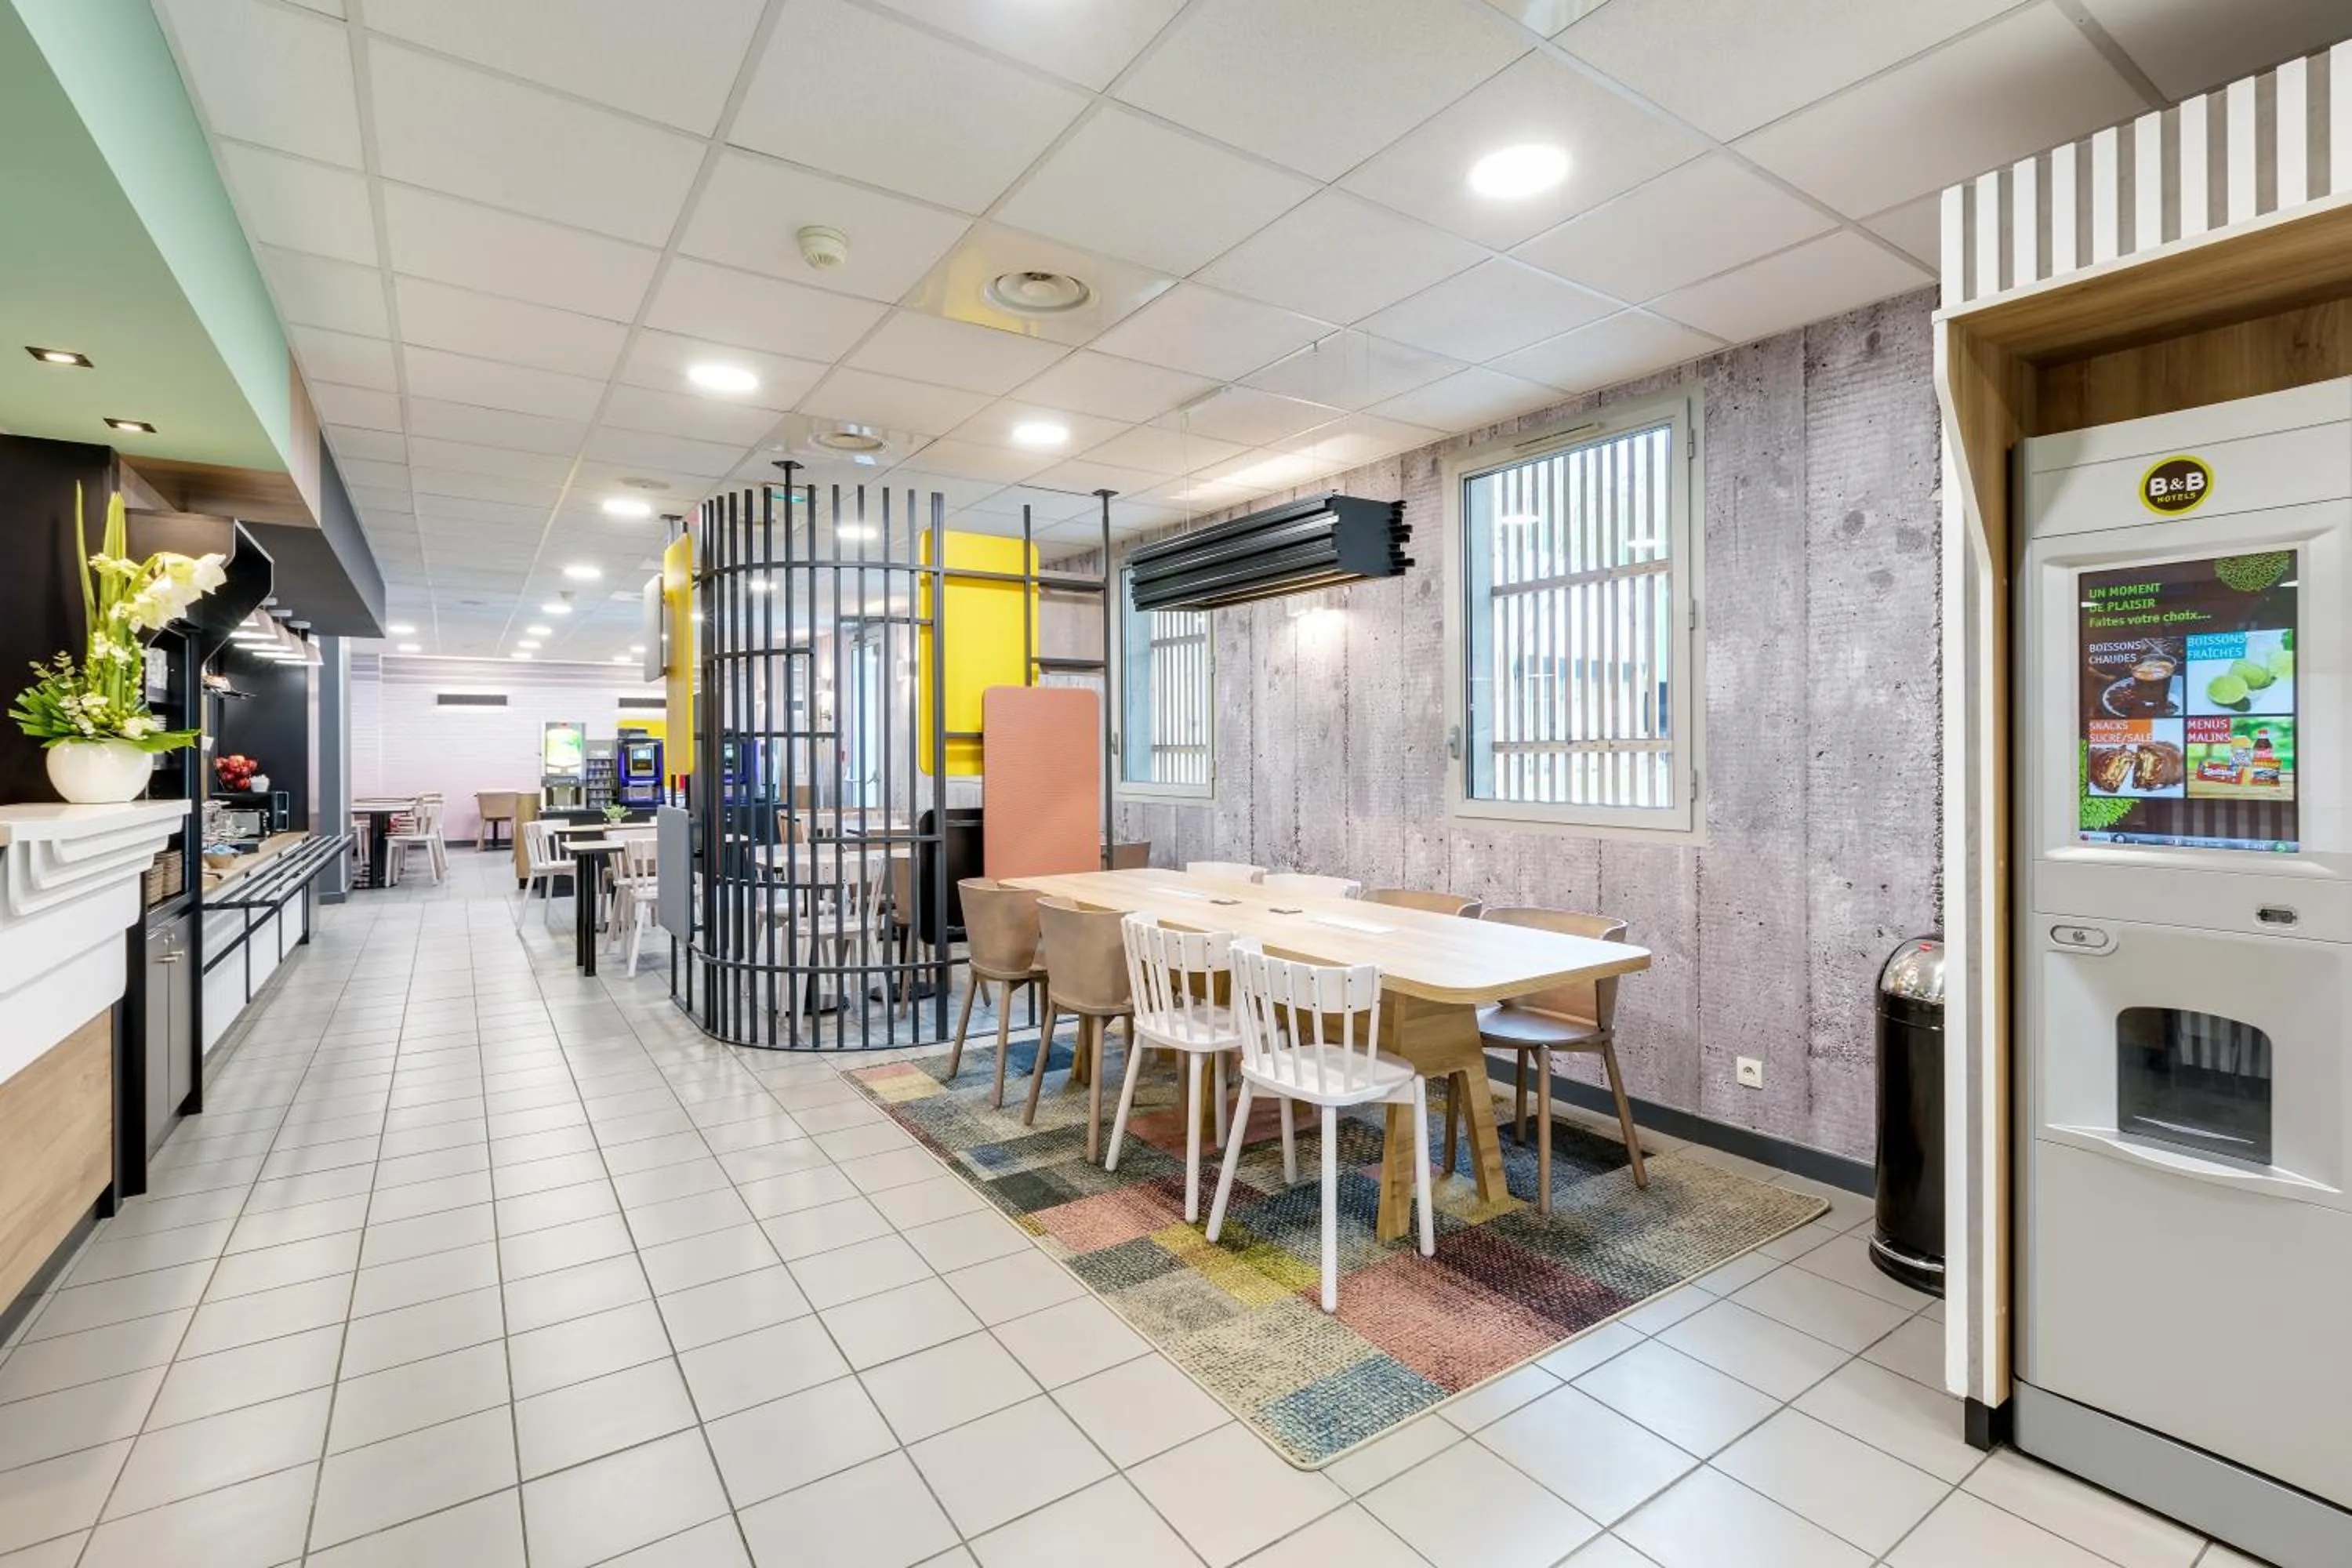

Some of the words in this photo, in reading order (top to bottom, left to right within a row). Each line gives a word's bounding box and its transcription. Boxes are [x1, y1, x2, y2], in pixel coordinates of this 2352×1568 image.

[2150, 472, 2205, 496] B&B
[2158, 492, 2196, 503] HOTELS
[2089, 589, 2105, 598] UN
[2109, 583, 2161, 597] MOMENT
[2107, 598, 2155, 612] PLAISIR
[2089, 616, 2125, 627] Faites
[2127, 614, 2160, 625] votre
[2188, 632, 2245, 647] BOISSONS
[2089, 641, 2141, 653] BOISSONS
[2089, 653, 2136, 664] CHAUDES
[2089, 720, 2129, 731] SNACKS
[2187, 719, 2227, 730] MENUS
[2187, 731, 2230, 742] MALINS
